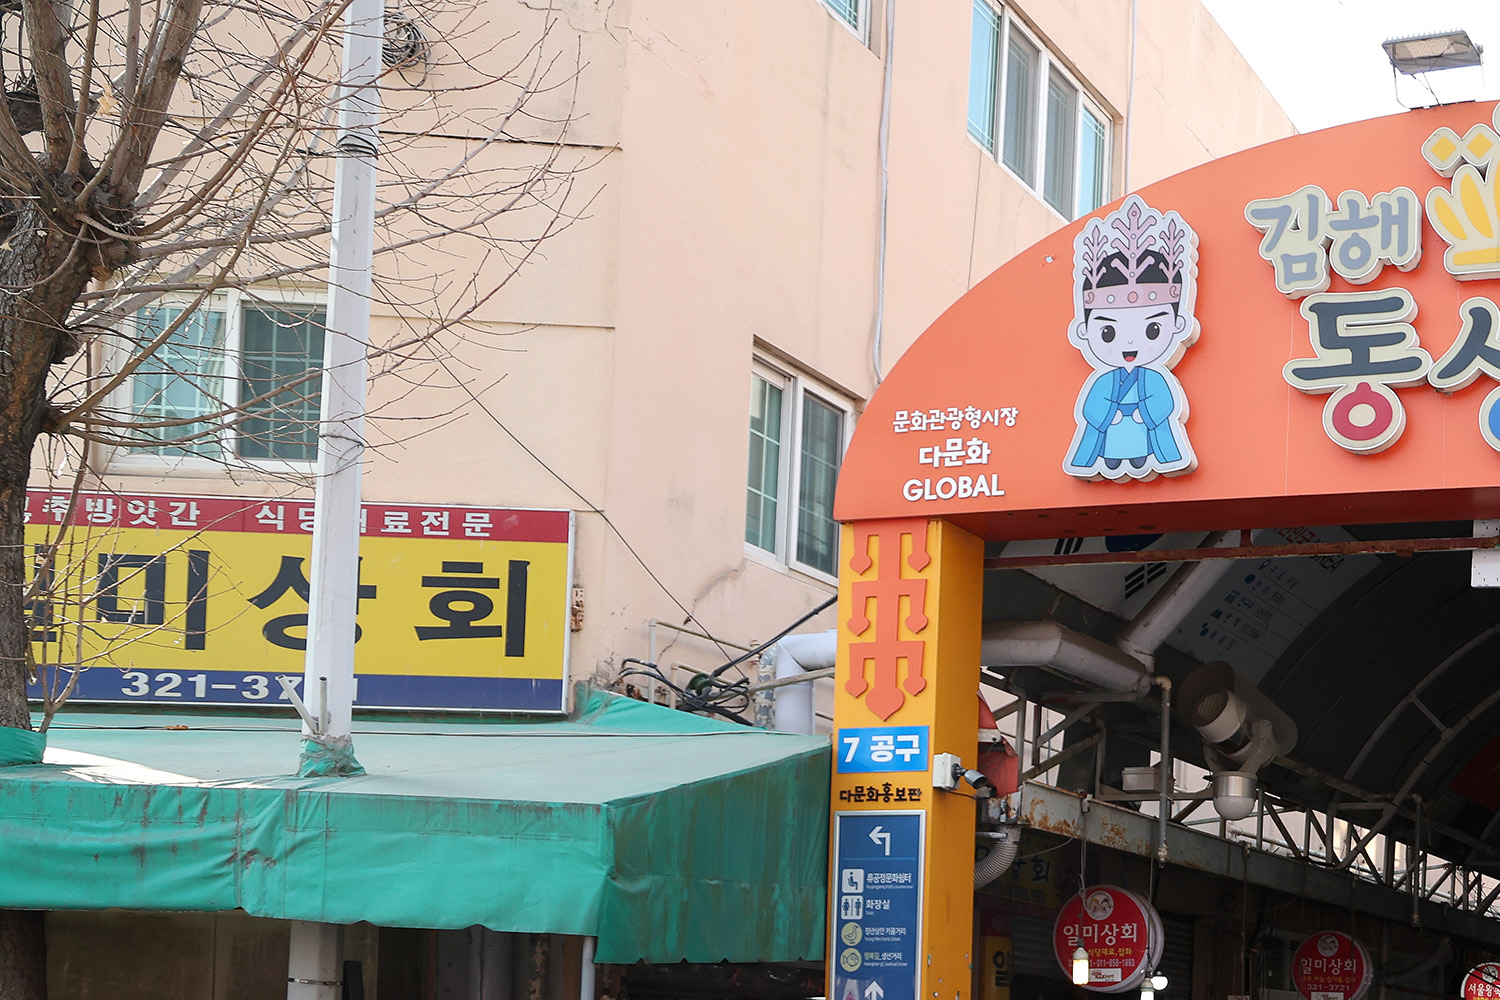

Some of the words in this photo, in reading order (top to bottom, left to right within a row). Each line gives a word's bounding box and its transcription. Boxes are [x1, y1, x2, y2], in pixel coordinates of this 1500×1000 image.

[1250, 188, 1415, 283] 김해
[892, 405, 1019, 432] 문화관광형시장
[918, 437, 991, 466] 다문화
[902, 473, 1005, 502] GLOBAL
[24, 496, 201, 526] 추방앗간
[842, 736, 860, 763] 7
[869, 734, 921, 764] 공구
[838, 782, 922, 803] 다문화홍보판
[865, 899, 890, 910] 화장실
[1063, 923, 1137, 946] 일미상회
[1300, 958, 1357, 975] 일미상회
